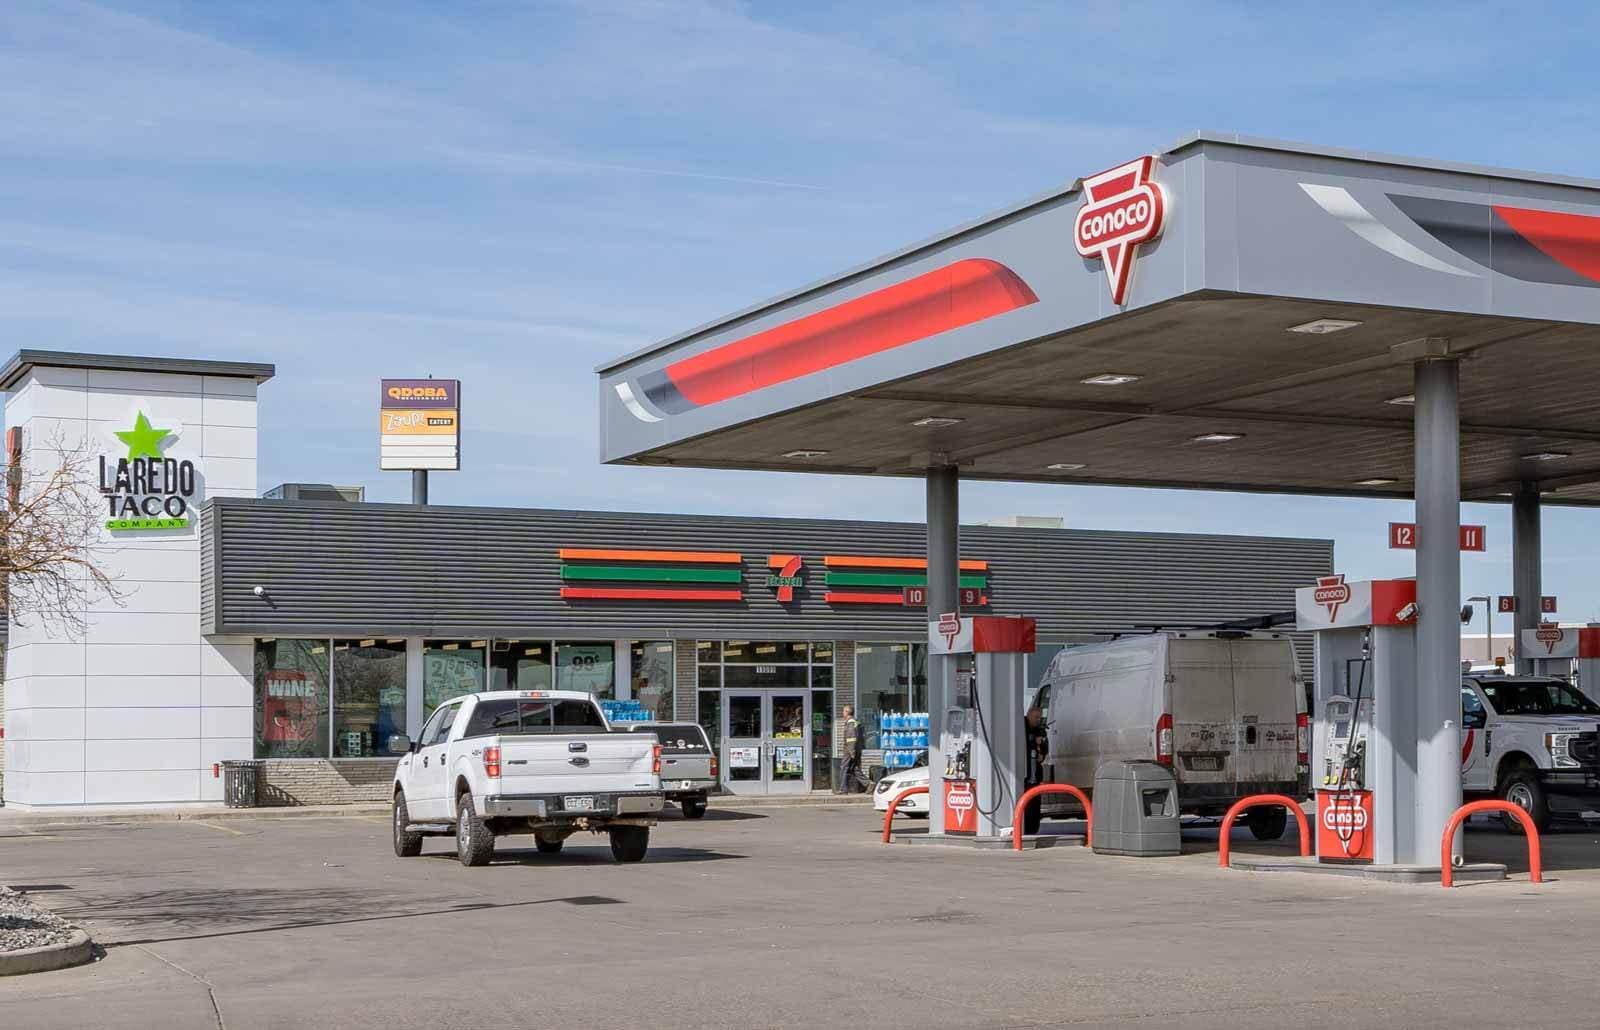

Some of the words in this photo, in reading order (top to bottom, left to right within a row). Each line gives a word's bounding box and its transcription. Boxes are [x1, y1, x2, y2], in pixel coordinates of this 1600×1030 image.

[388, 387, 448, 400] QDOBA
[99, 455, 194, 497] LAREDO
[104, 495, 186, 518] TACO
[108, 518, 185, 528] COMPANY
[1397, 527, 1411, 545] 12
[1466, 530, 1476, 547] 11
[767, 555, 802, 601] 7
[910, 590, 922, 603] 10
[966, 590, 974, 603] 9
[1502, 599, 1509, 610] 6
[1544, 599, 1551, 610] 5
[267, 680, 316, 697] WINE
